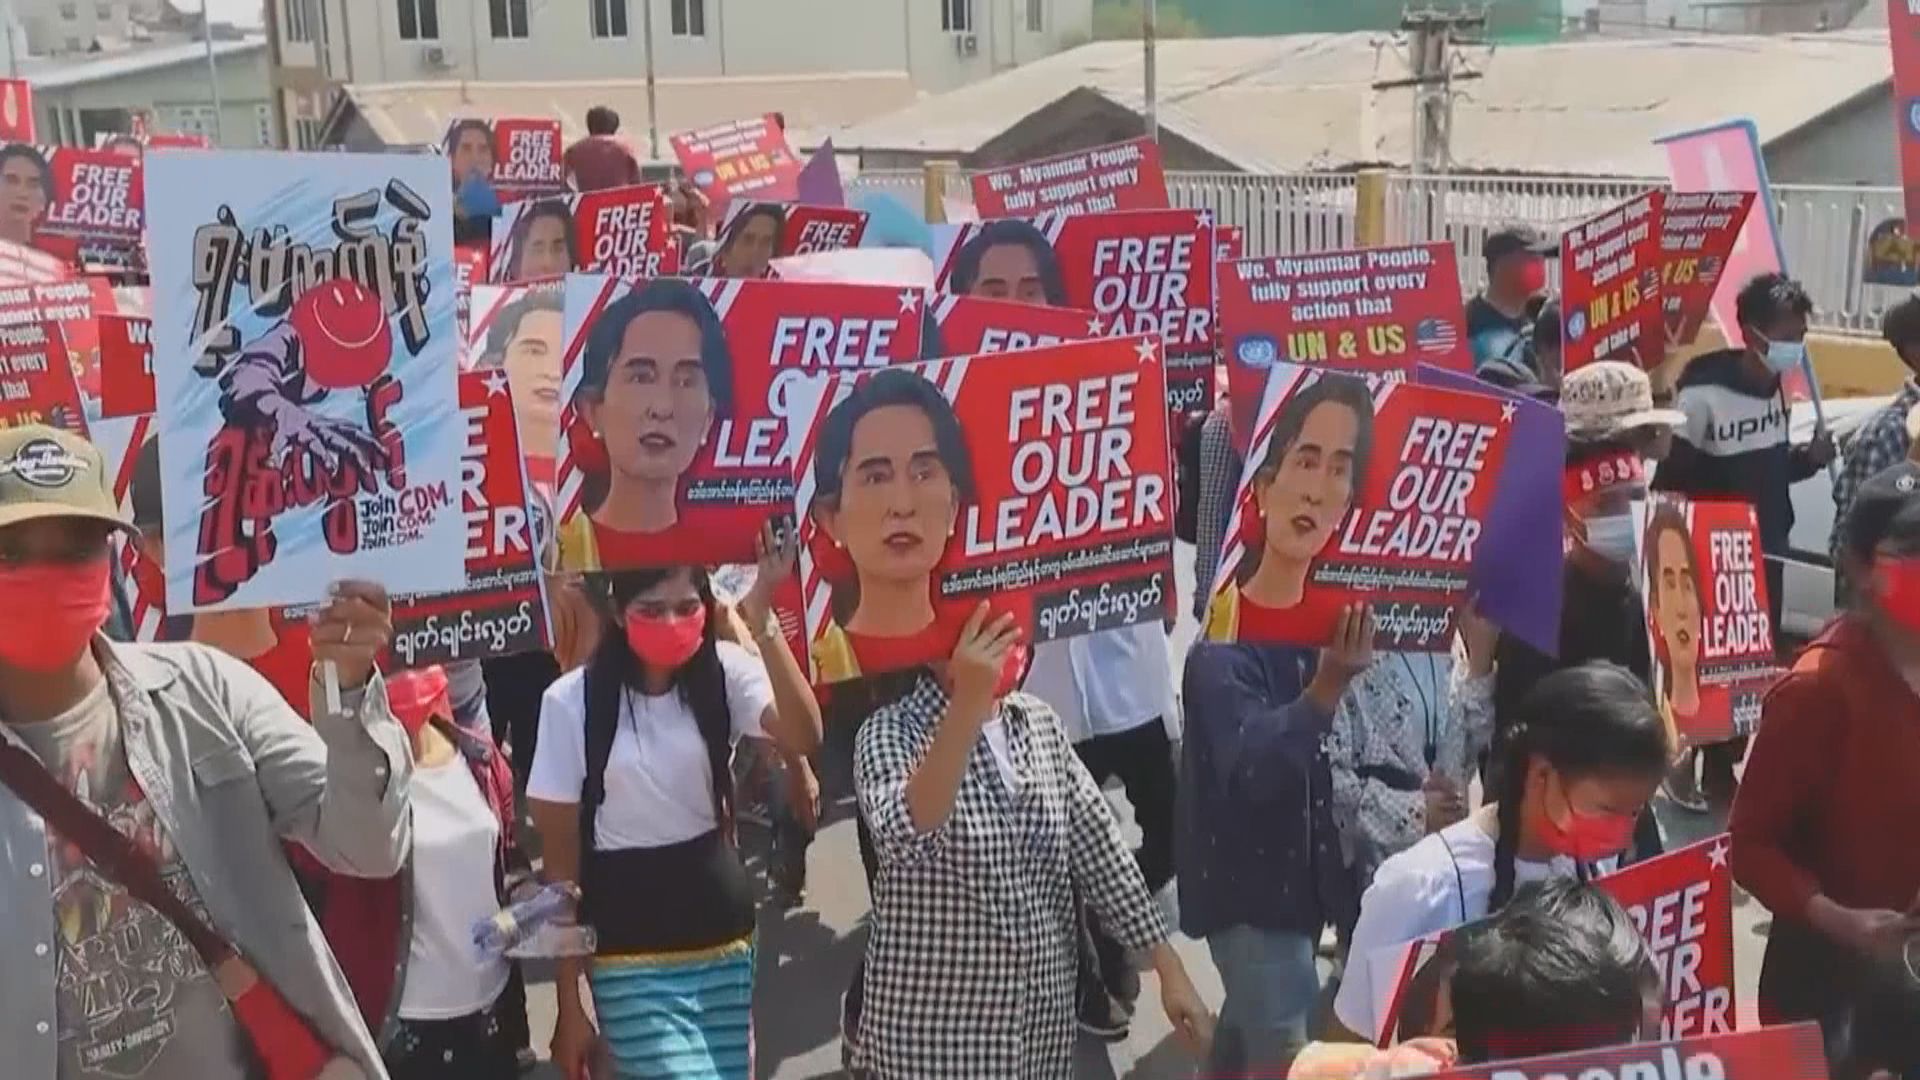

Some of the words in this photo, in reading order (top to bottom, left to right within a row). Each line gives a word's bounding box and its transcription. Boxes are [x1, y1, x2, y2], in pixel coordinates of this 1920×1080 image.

[509, 130, 553, 149] FREE
[510, 146, 551, 165] OUR
[71, 163, 132, 188] FREE
[493, 162, 561, 182] LEADER
[1003, 190, 1036, 210] fully
[1038, 175, 1097, 202] support
[1099, 167, 1139, 189] every
[1019, 156, 1088, 184] Myanmar
[71, 183, 128, 208] OUR
[46, 202, 140, 230] LEADER
[594, 201, 655, 236] FREE
[800, 220, 855, 243] FREE
[594, 229, 649, 261] OUR
[1092, 234, 1196, 275] FREE
[586, 252, 661, 279] ADER
[1275, 254, 1361, 278] Myanmar
[1673, 258, 1698, 284] US
[1093, 273, 1188, 314] OUR
[1251, 281, 1291, 303] fully
[1296, 274, 1371, 300] support
[1374, 271, 1427, 292] every
[1591, 292, 1609, 329] UN
[1611, 291, 1620, 318] &
[1623, 276, 1640, 312] US
[1111, 308, 1211, 345] ADER
[1291, 300, 1350, 322] action
[1354, 295, 1393, 316] that
[769, 316, 898, 366] FREE
[1287, 330, 1328, 362] UN
[1337, 332, 1358, 359] &
[1366, 324, 1407, 356] US
[1009, 372, 1139, 443] FREE
[1011, 427, 1133, 494] OUR
[1400, 416, 1498, 472] FREE
[360, 494, 395, 517] Join
[399, 480, 454, 516] CDM.
[1389, 465, 1477, 515] OUR
[362, 516, 394, 535] Join
[965, 473, 1165, 557] LEADER
[1339, 507, 1482, 562] LEADER
[1710, 531, 1755, 576] FREE
[1039, 573, 1163, 639] ချက်ချင်းလွှတ်
[1715, 573, 1758, 613] OUR
[395, 601, 532, 665] ချက်ချင်းလွှတ်
[1702, 613, 1772, 657] LEADER
[1626, 880, 1711, 951] REE
